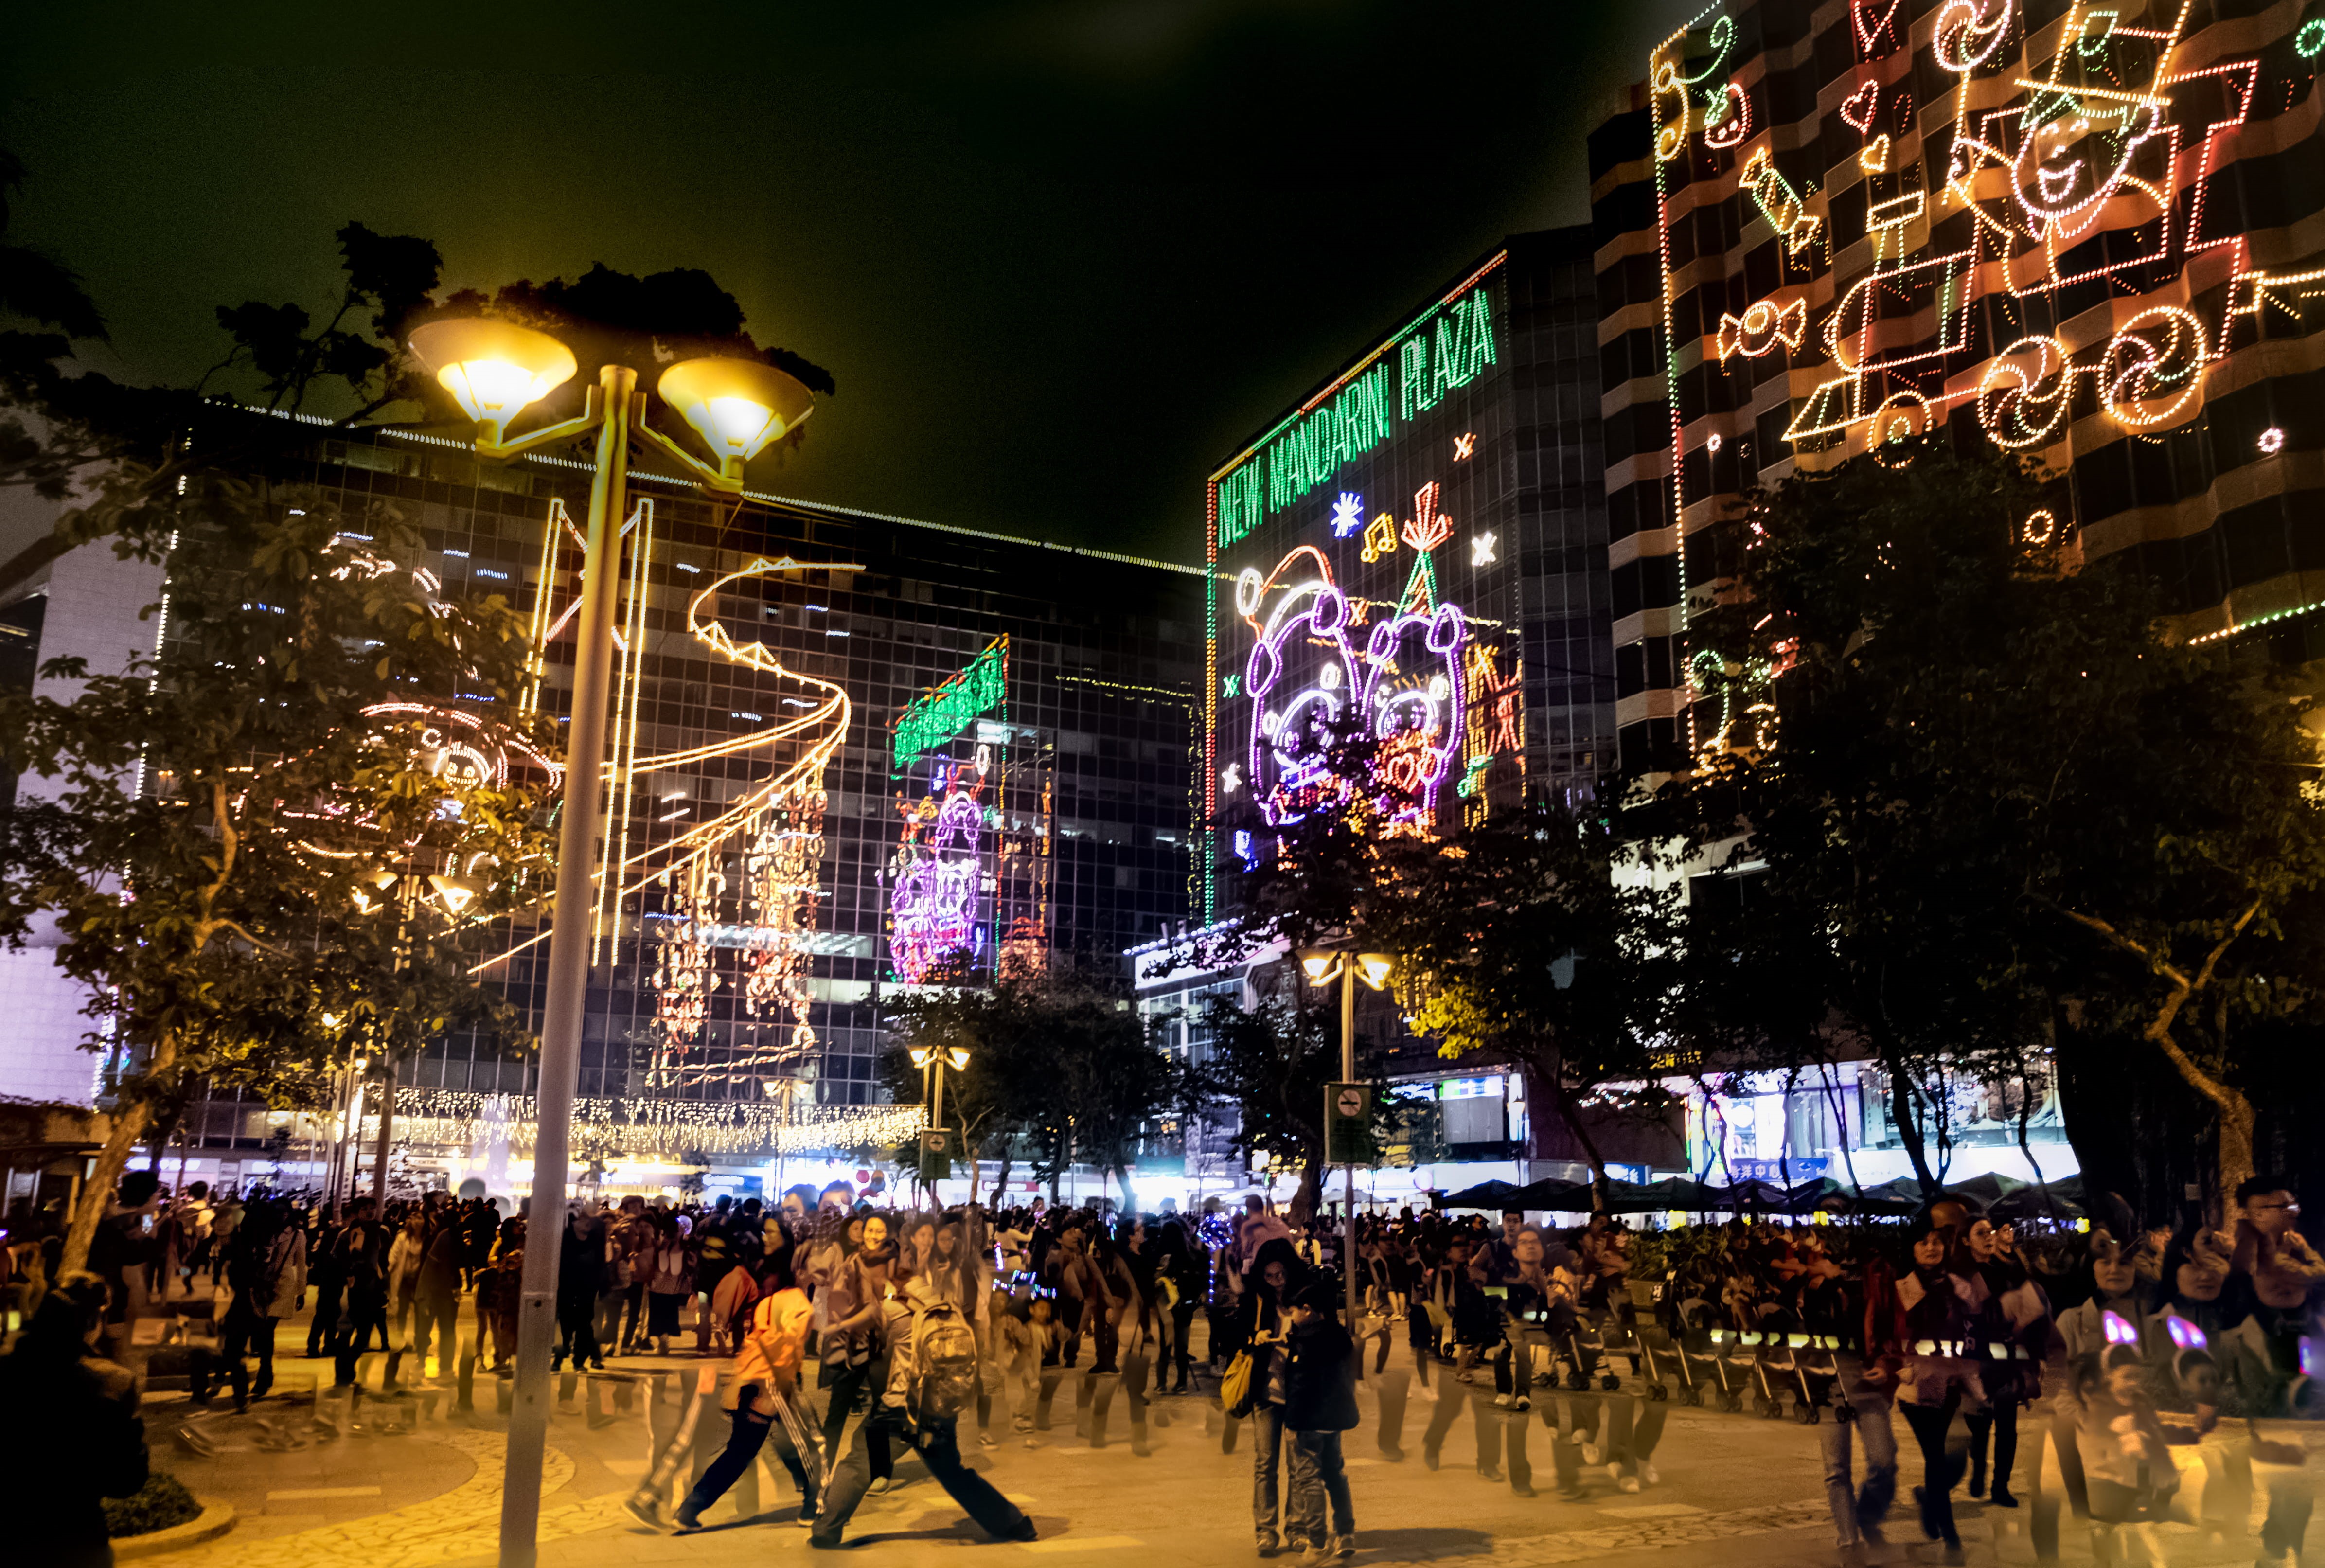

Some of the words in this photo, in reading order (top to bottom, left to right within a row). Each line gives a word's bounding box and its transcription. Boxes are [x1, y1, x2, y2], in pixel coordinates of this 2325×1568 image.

[1218, 454, 1262, 548] NEW
[1269, 362, 1387, 514] MANDARIN
[1401, 288, 1494, 420] PLAZA
